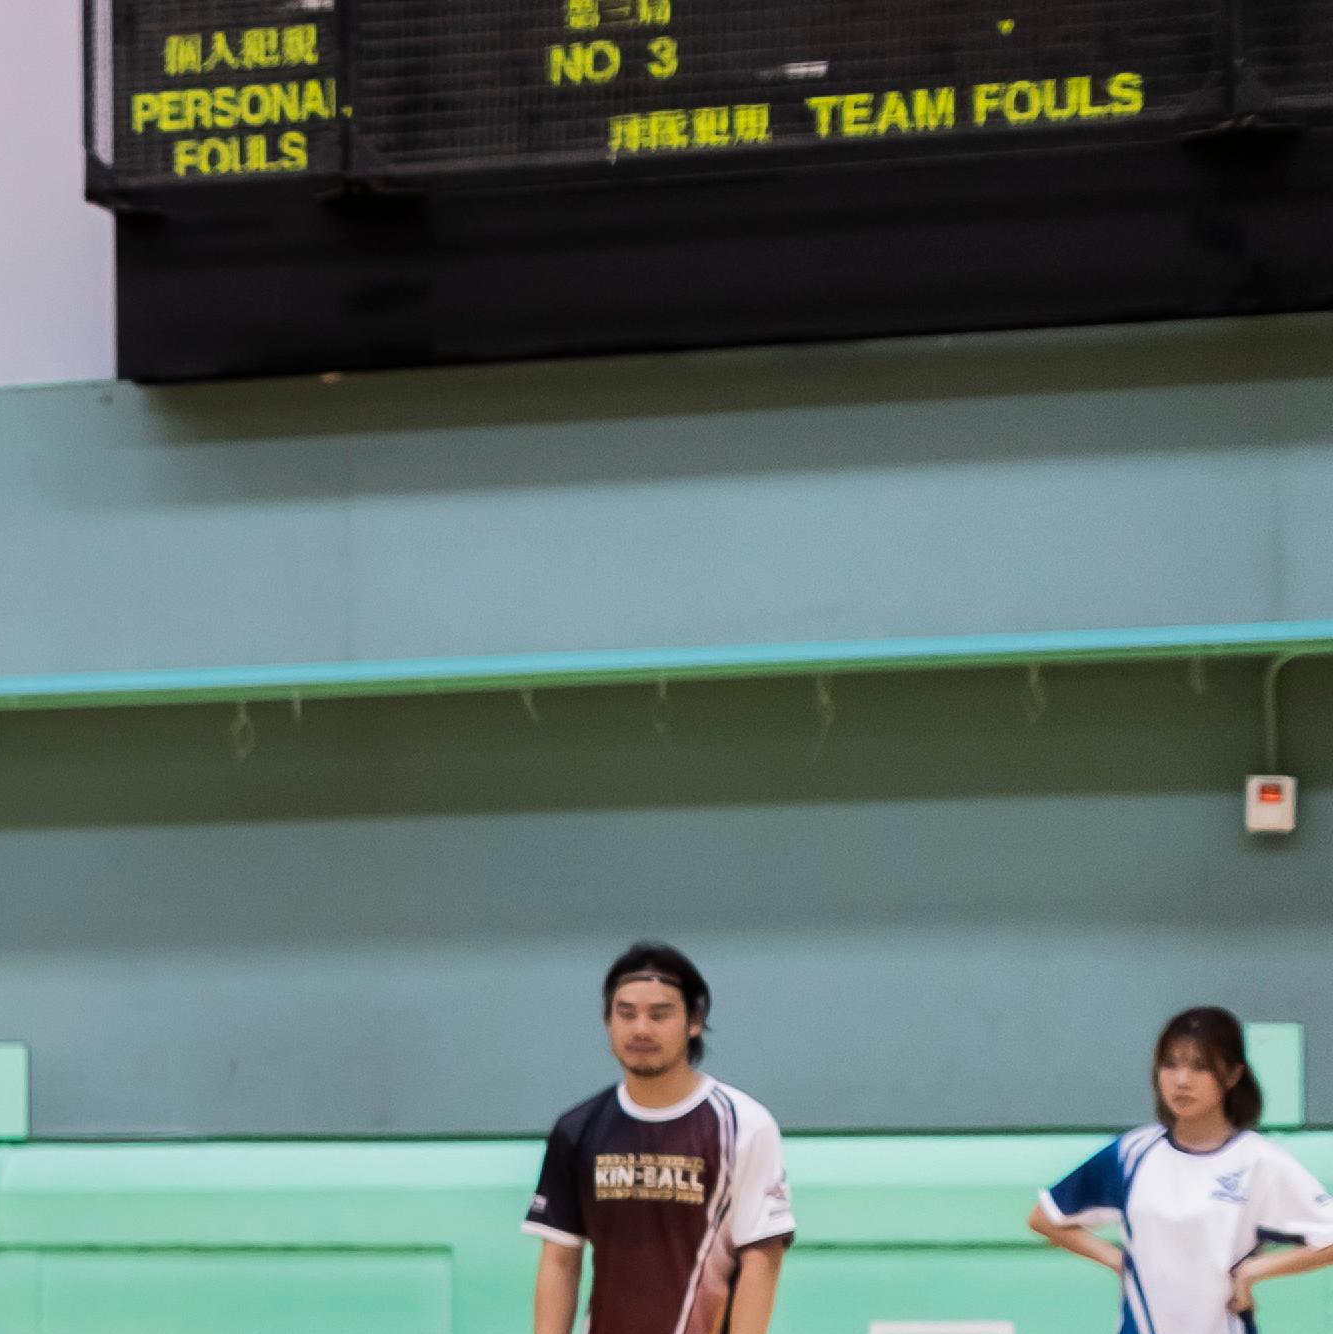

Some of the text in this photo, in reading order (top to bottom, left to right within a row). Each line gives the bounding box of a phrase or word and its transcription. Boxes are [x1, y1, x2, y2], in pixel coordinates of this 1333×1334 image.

[546, 35, 679, 87] NO 3
[805, 71, 1145, 139] TEAM FOULS
[173, 130, 308, 176] FOULS
[595, 1165, 704, 1192] KIN-BALL
